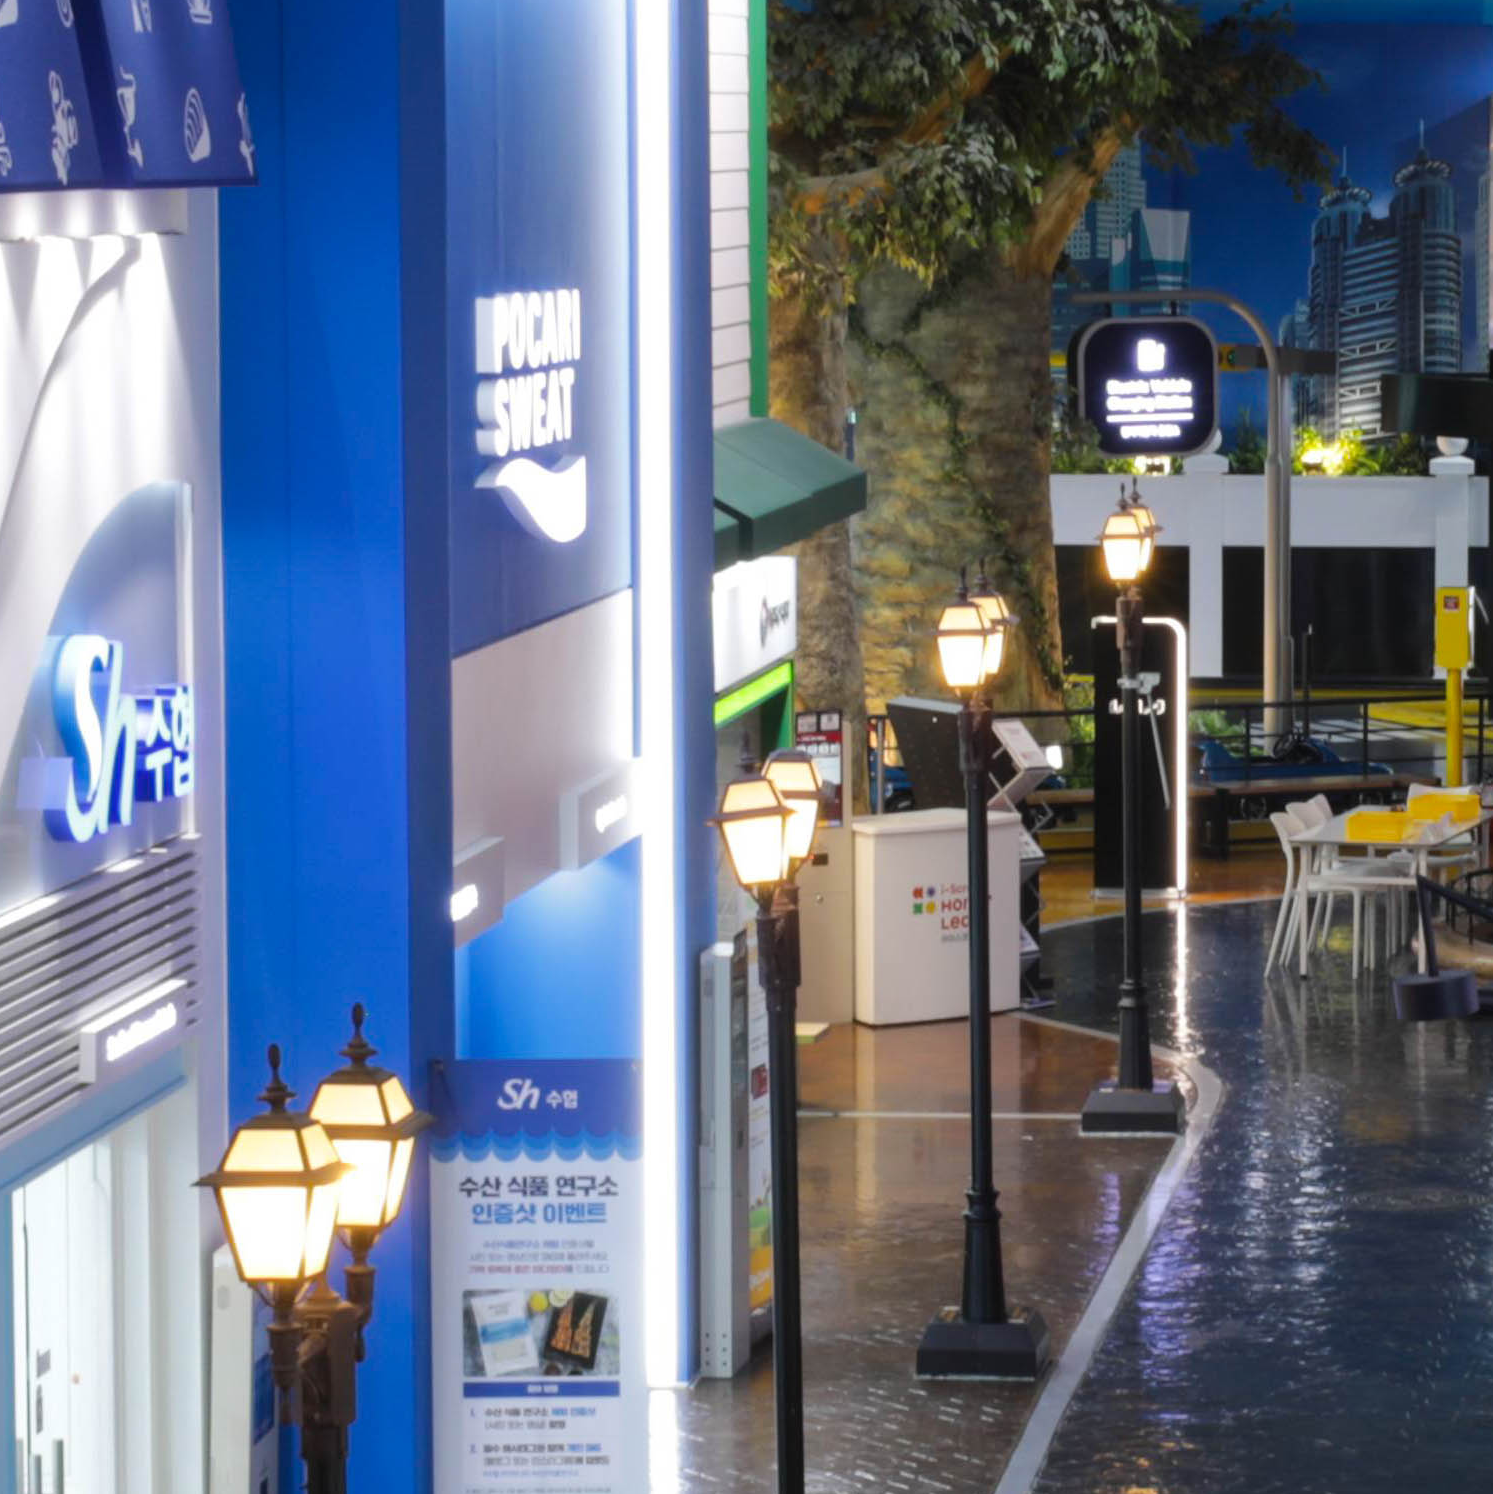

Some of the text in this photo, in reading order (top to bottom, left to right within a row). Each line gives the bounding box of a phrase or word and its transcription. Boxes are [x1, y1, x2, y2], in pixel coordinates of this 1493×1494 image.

[493, 287, 581, 373] POCARI
[493, 366, 575, 458] SWEAT
[56, 634, 137, 844] Sh
[497, 1078, 541, 1110] Sh
[459, 1176, 619, 1198] 수산 식품 연구소
[472, 1203, 607, 1225] 인증샷 이벤트
